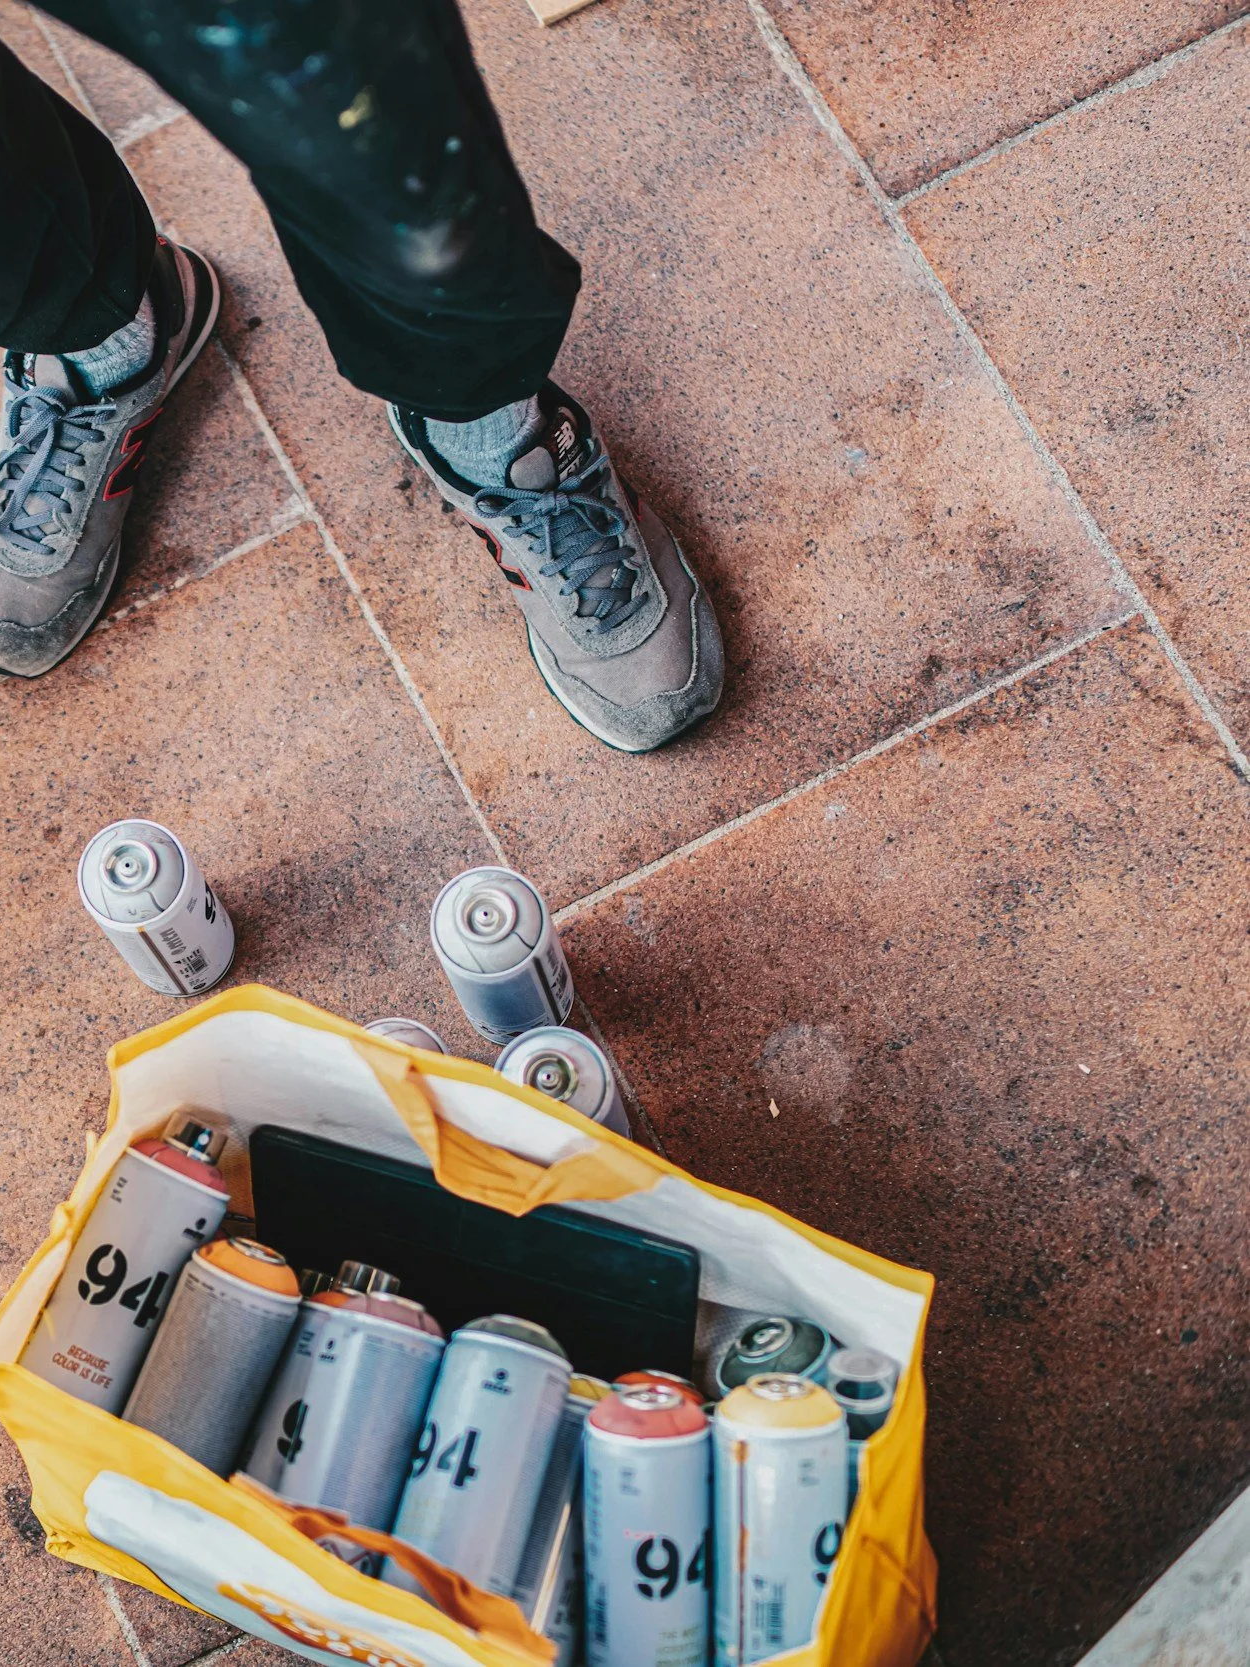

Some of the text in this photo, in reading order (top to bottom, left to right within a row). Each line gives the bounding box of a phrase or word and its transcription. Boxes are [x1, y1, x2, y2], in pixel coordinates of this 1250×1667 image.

[78, 1244, 169, 1328] 94
[52, 1352, 113, 1389] COLOR IS LIFE
[67, 1344, 110, 1372] BECAUSE
[814, 1521, 842, 1585] 9
